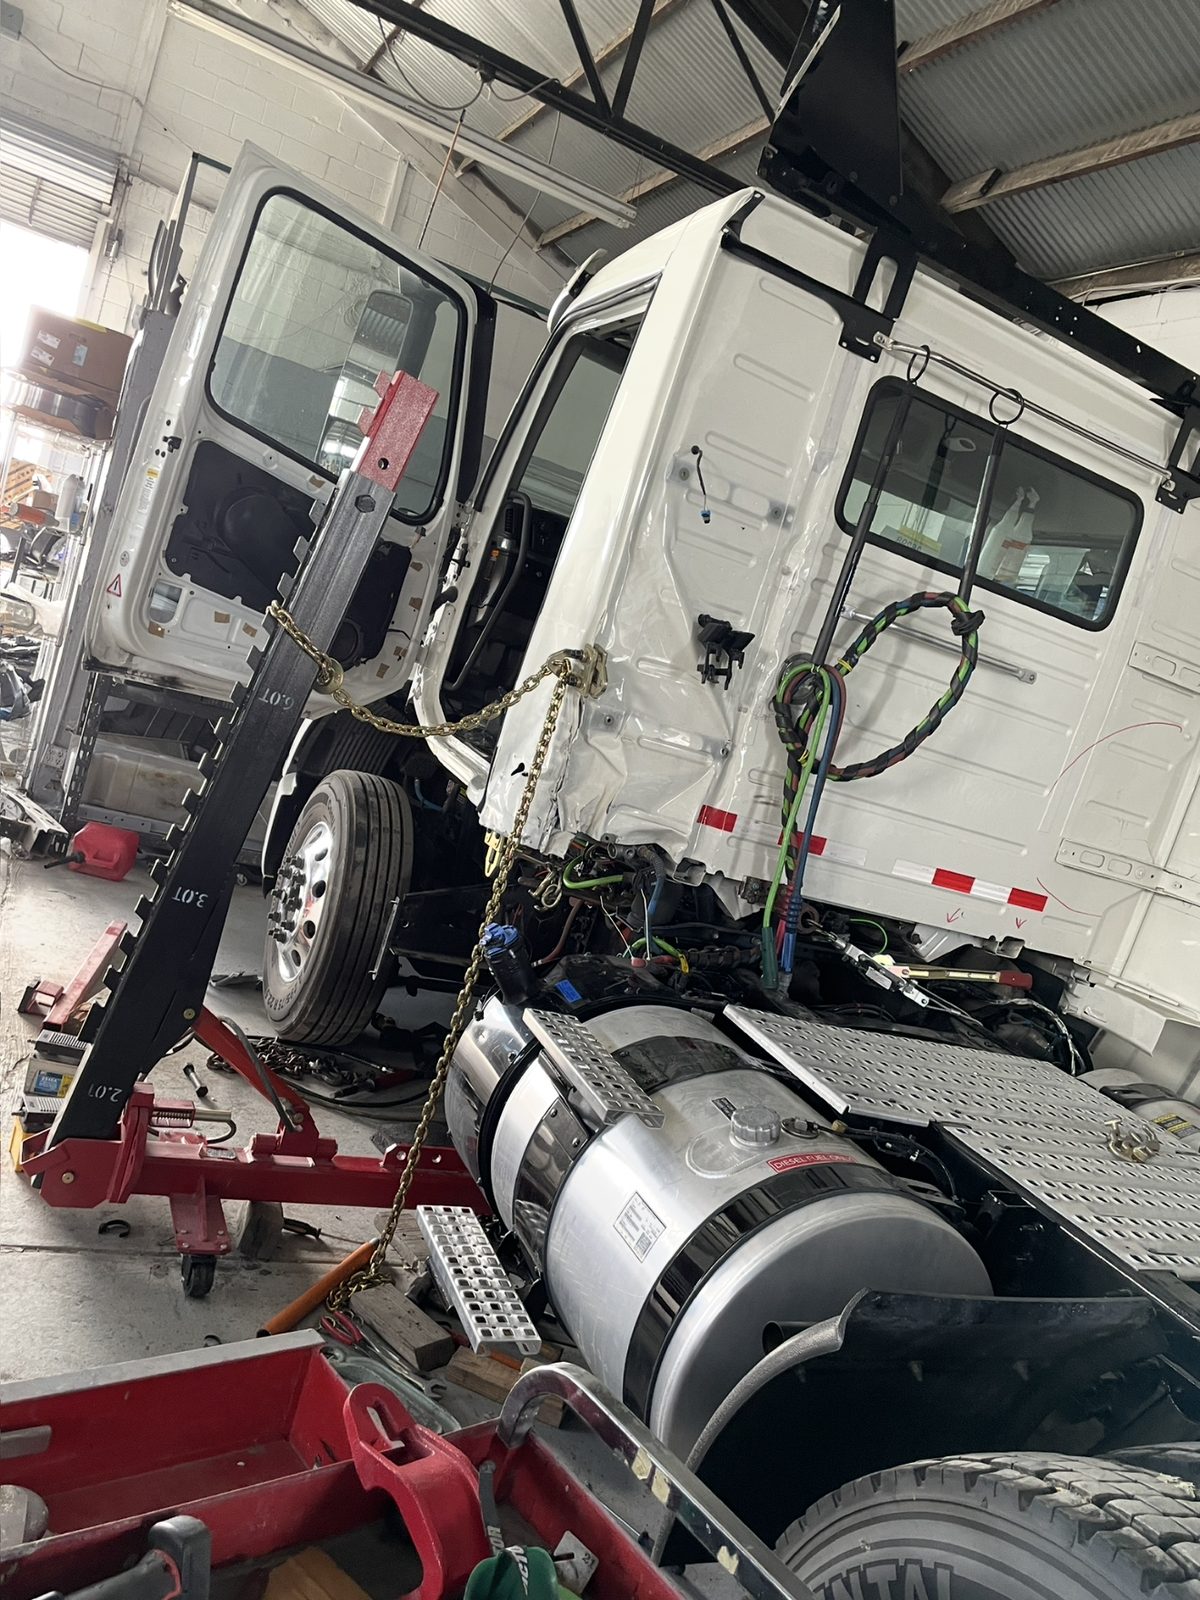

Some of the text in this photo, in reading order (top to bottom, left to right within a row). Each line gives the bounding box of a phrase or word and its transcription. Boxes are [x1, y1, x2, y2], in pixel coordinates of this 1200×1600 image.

[258, 687, 295, 710] 6.0T
[171, 886, 208, 908] 3.0T
[88, 1083, 123, 1102] 2.0T
[773, 1155, 807, 1169] DIESEL
